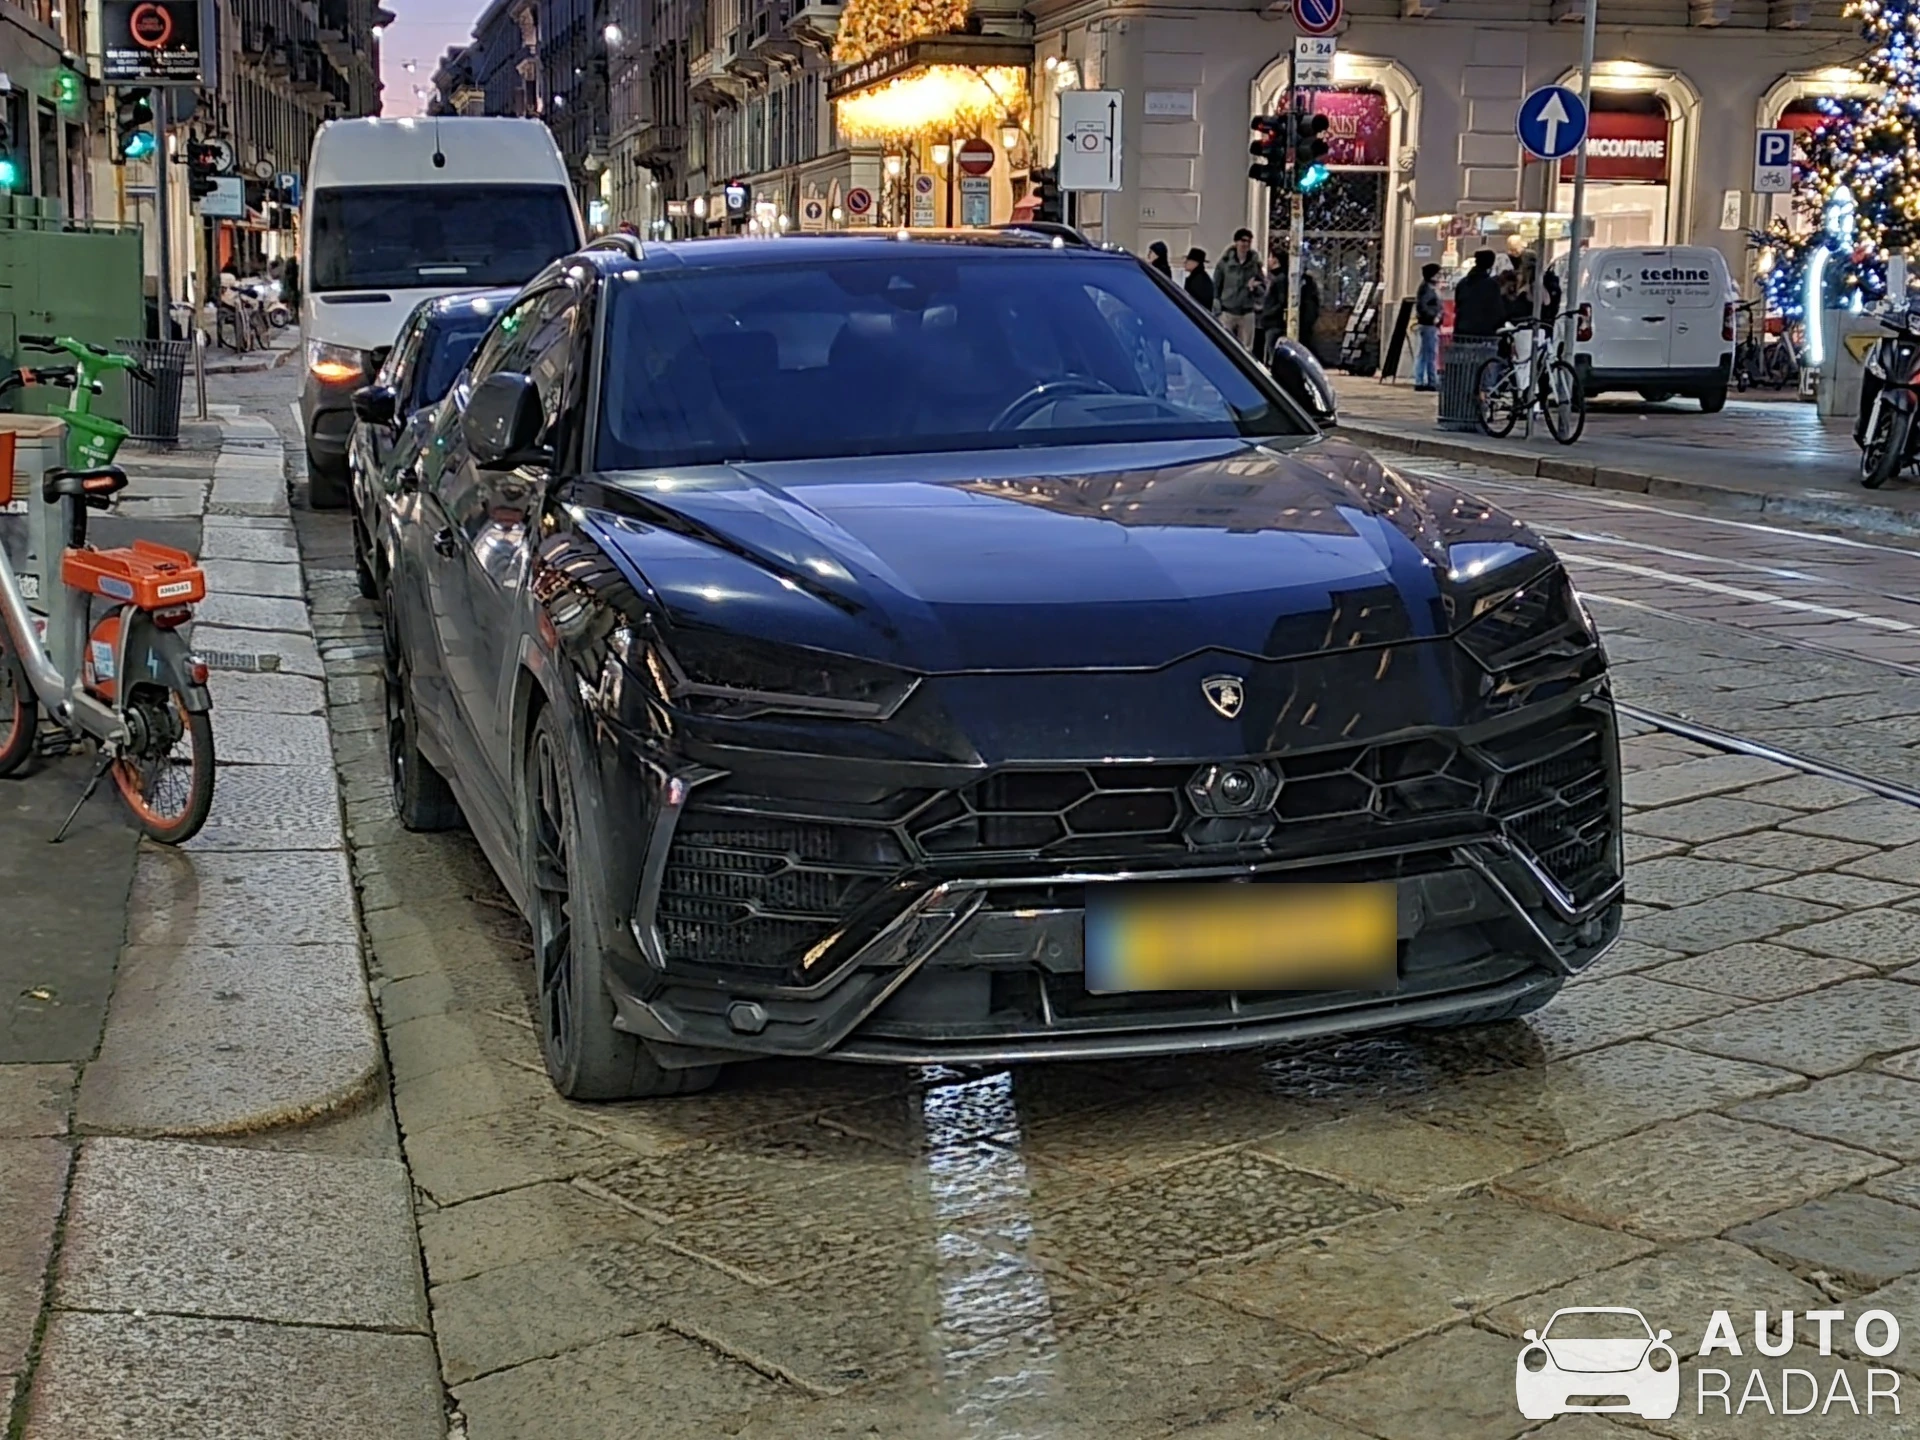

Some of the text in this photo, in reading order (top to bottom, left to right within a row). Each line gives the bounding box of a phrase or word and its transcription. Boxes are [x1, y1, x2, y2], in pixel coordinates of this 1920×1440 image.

[1301, 43, 1308, 53] 0
[1316, 43, 1331, 54] 24
[1570, 138, 1665, 158] MICOUTURE
[1765, 136, 1785, 164] P
[1641, 268, 1709, 280] techne
